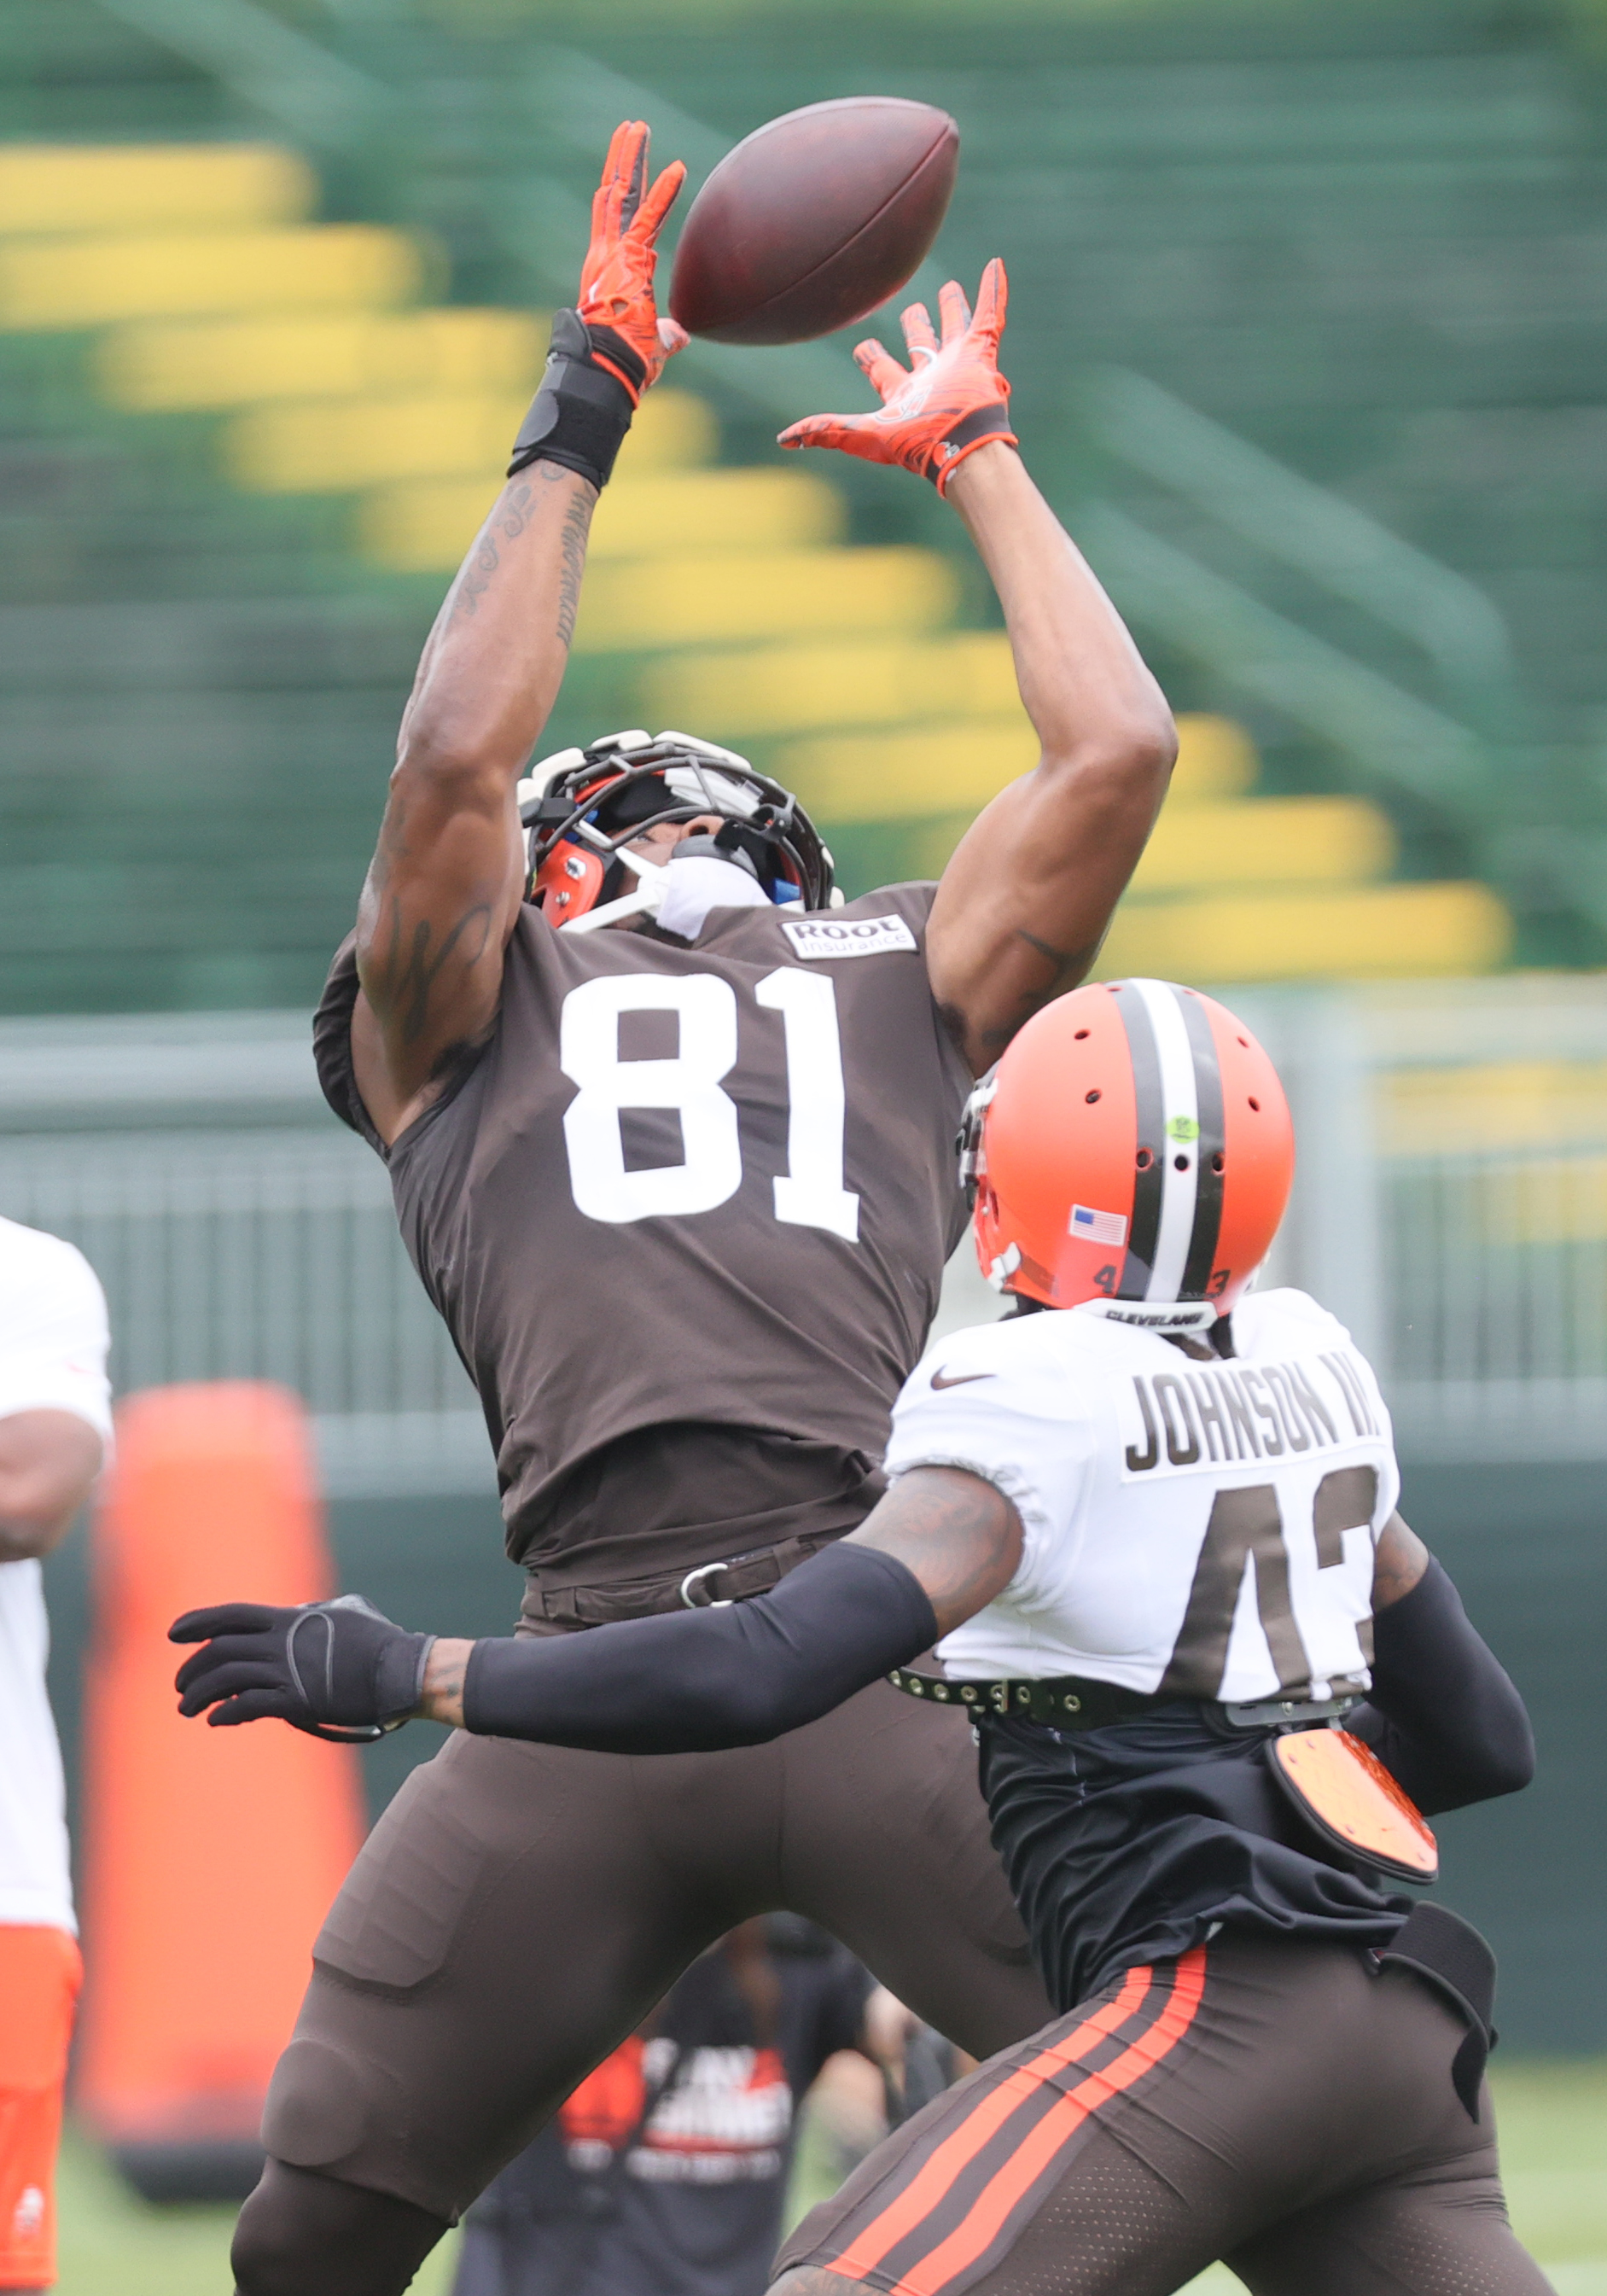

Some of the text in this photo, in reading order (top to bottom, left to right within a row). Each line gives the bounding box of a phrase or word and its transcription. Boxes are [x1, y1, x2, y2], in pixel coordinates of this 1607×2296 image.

[792, 919, 900, 940] Root
[560, 966, 860, 1244] 81
[1093, 1265, 1231, 1297] 4 3
[1105, 1309, 1205, 1327] CLEVELAND
[1126, 1362, 1339, 1471] JOHNSON
